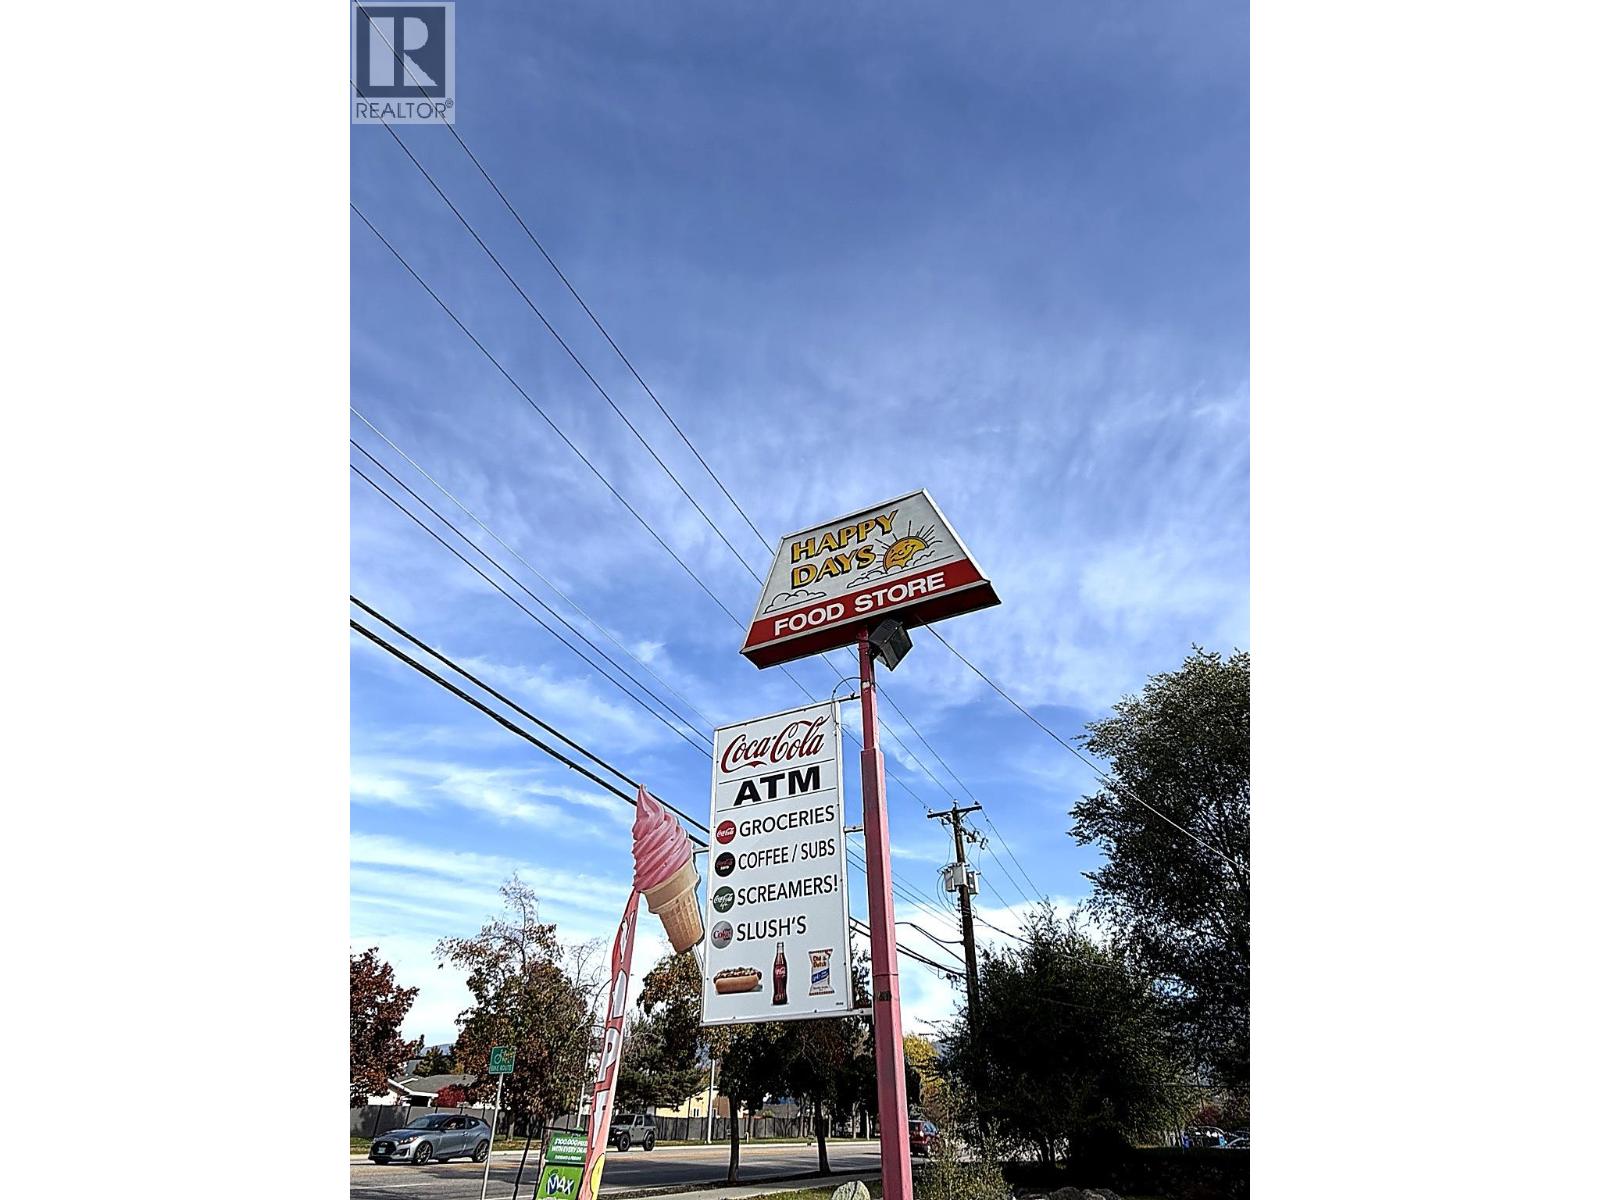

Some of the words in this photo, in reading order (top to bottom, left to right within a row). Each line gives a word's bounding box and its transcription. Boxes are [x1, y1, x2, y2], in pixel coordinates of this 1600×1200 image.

[791, 510, 898, 564] HAPPY
[792, 545, 876, 589] DAYS
[775, 603, 844, 636] FOOD
[855, 572, 945, 612] STORE
[733, 766, 820, 806] ATM
[740, 805, 834, 837] GROCERIES
[739, 847, 788, 870] COFFEE
[801, 839, 835, 860] SUBS
[737, 874, 838, 906] SCREAMERS!
[737, 915, 807, 941] SLUSH'S
[547, 1172, 575, 1196] MAX
